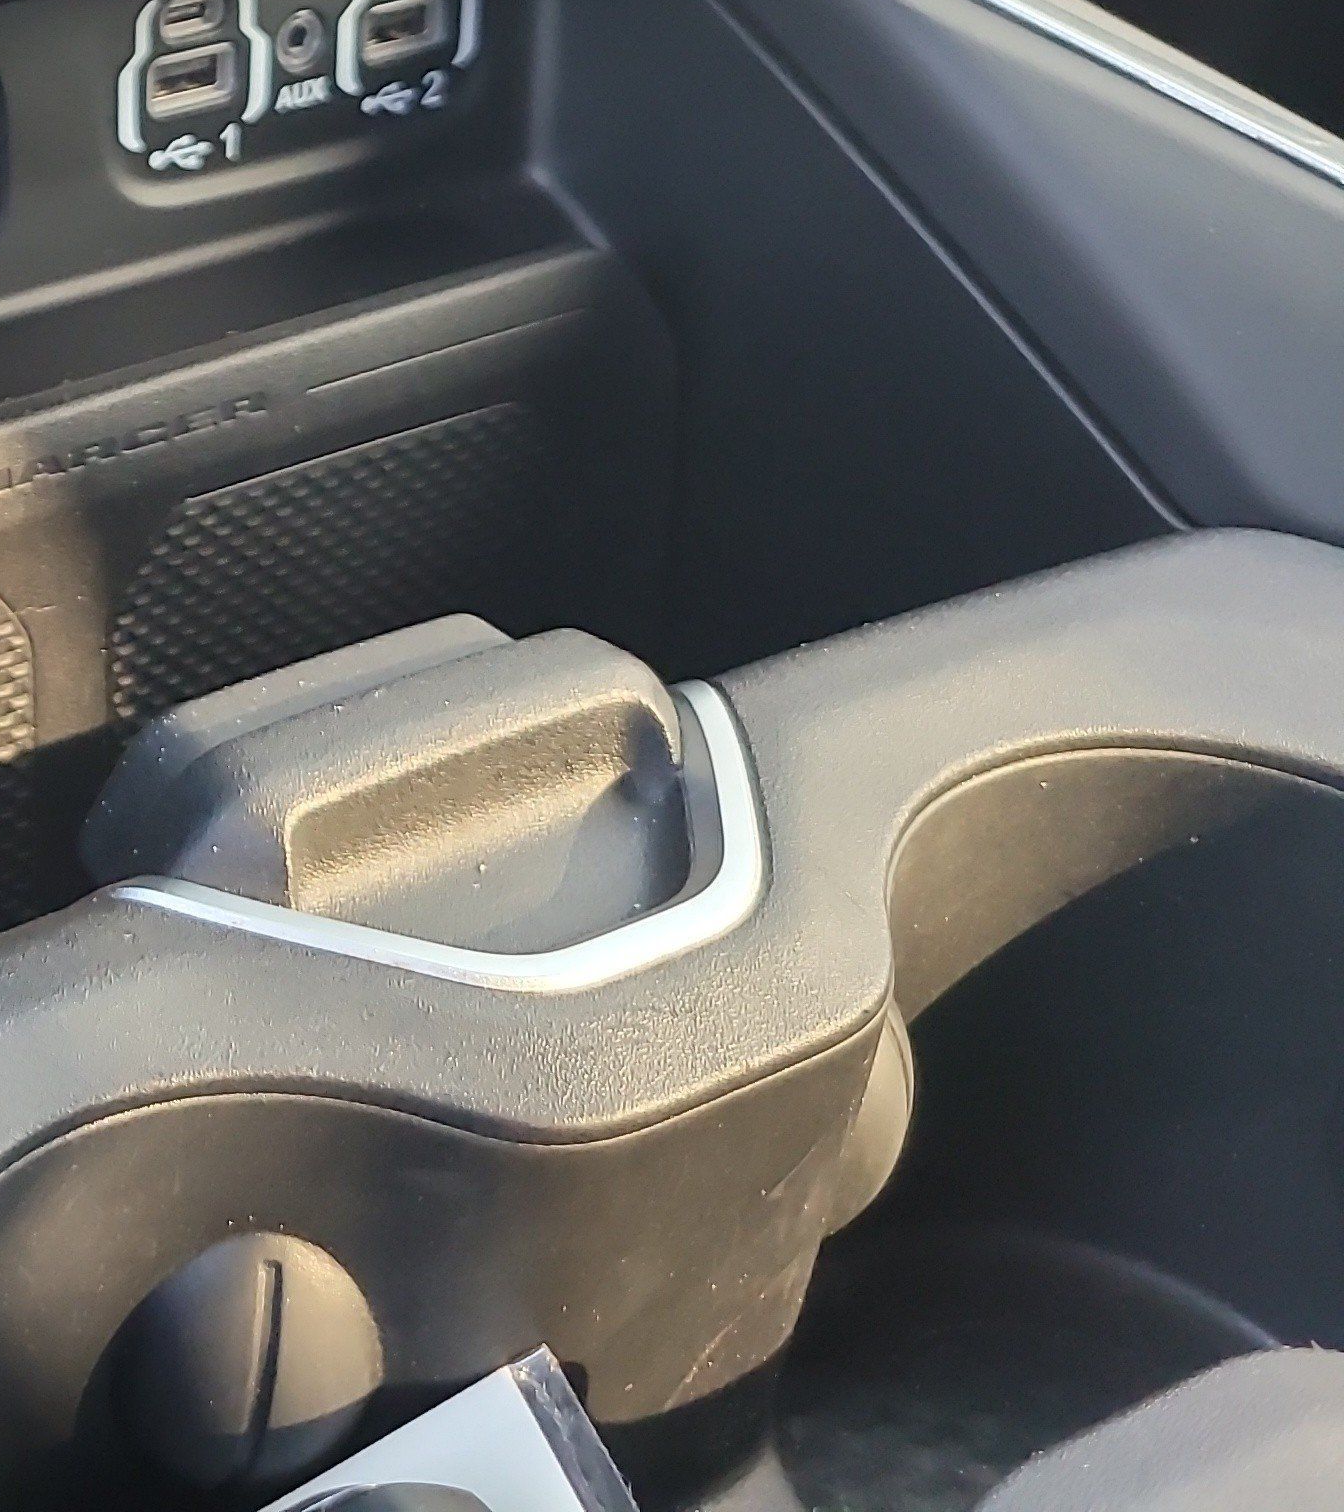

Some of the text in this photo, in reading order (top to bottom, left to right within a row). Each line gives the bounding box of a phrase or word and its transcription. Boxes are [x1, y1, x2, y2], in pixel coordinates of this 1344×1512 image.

[274, 73, 334, 113] AUX
[419, 70, 448, 109] 2
[219, 121, 243, 161] 1
